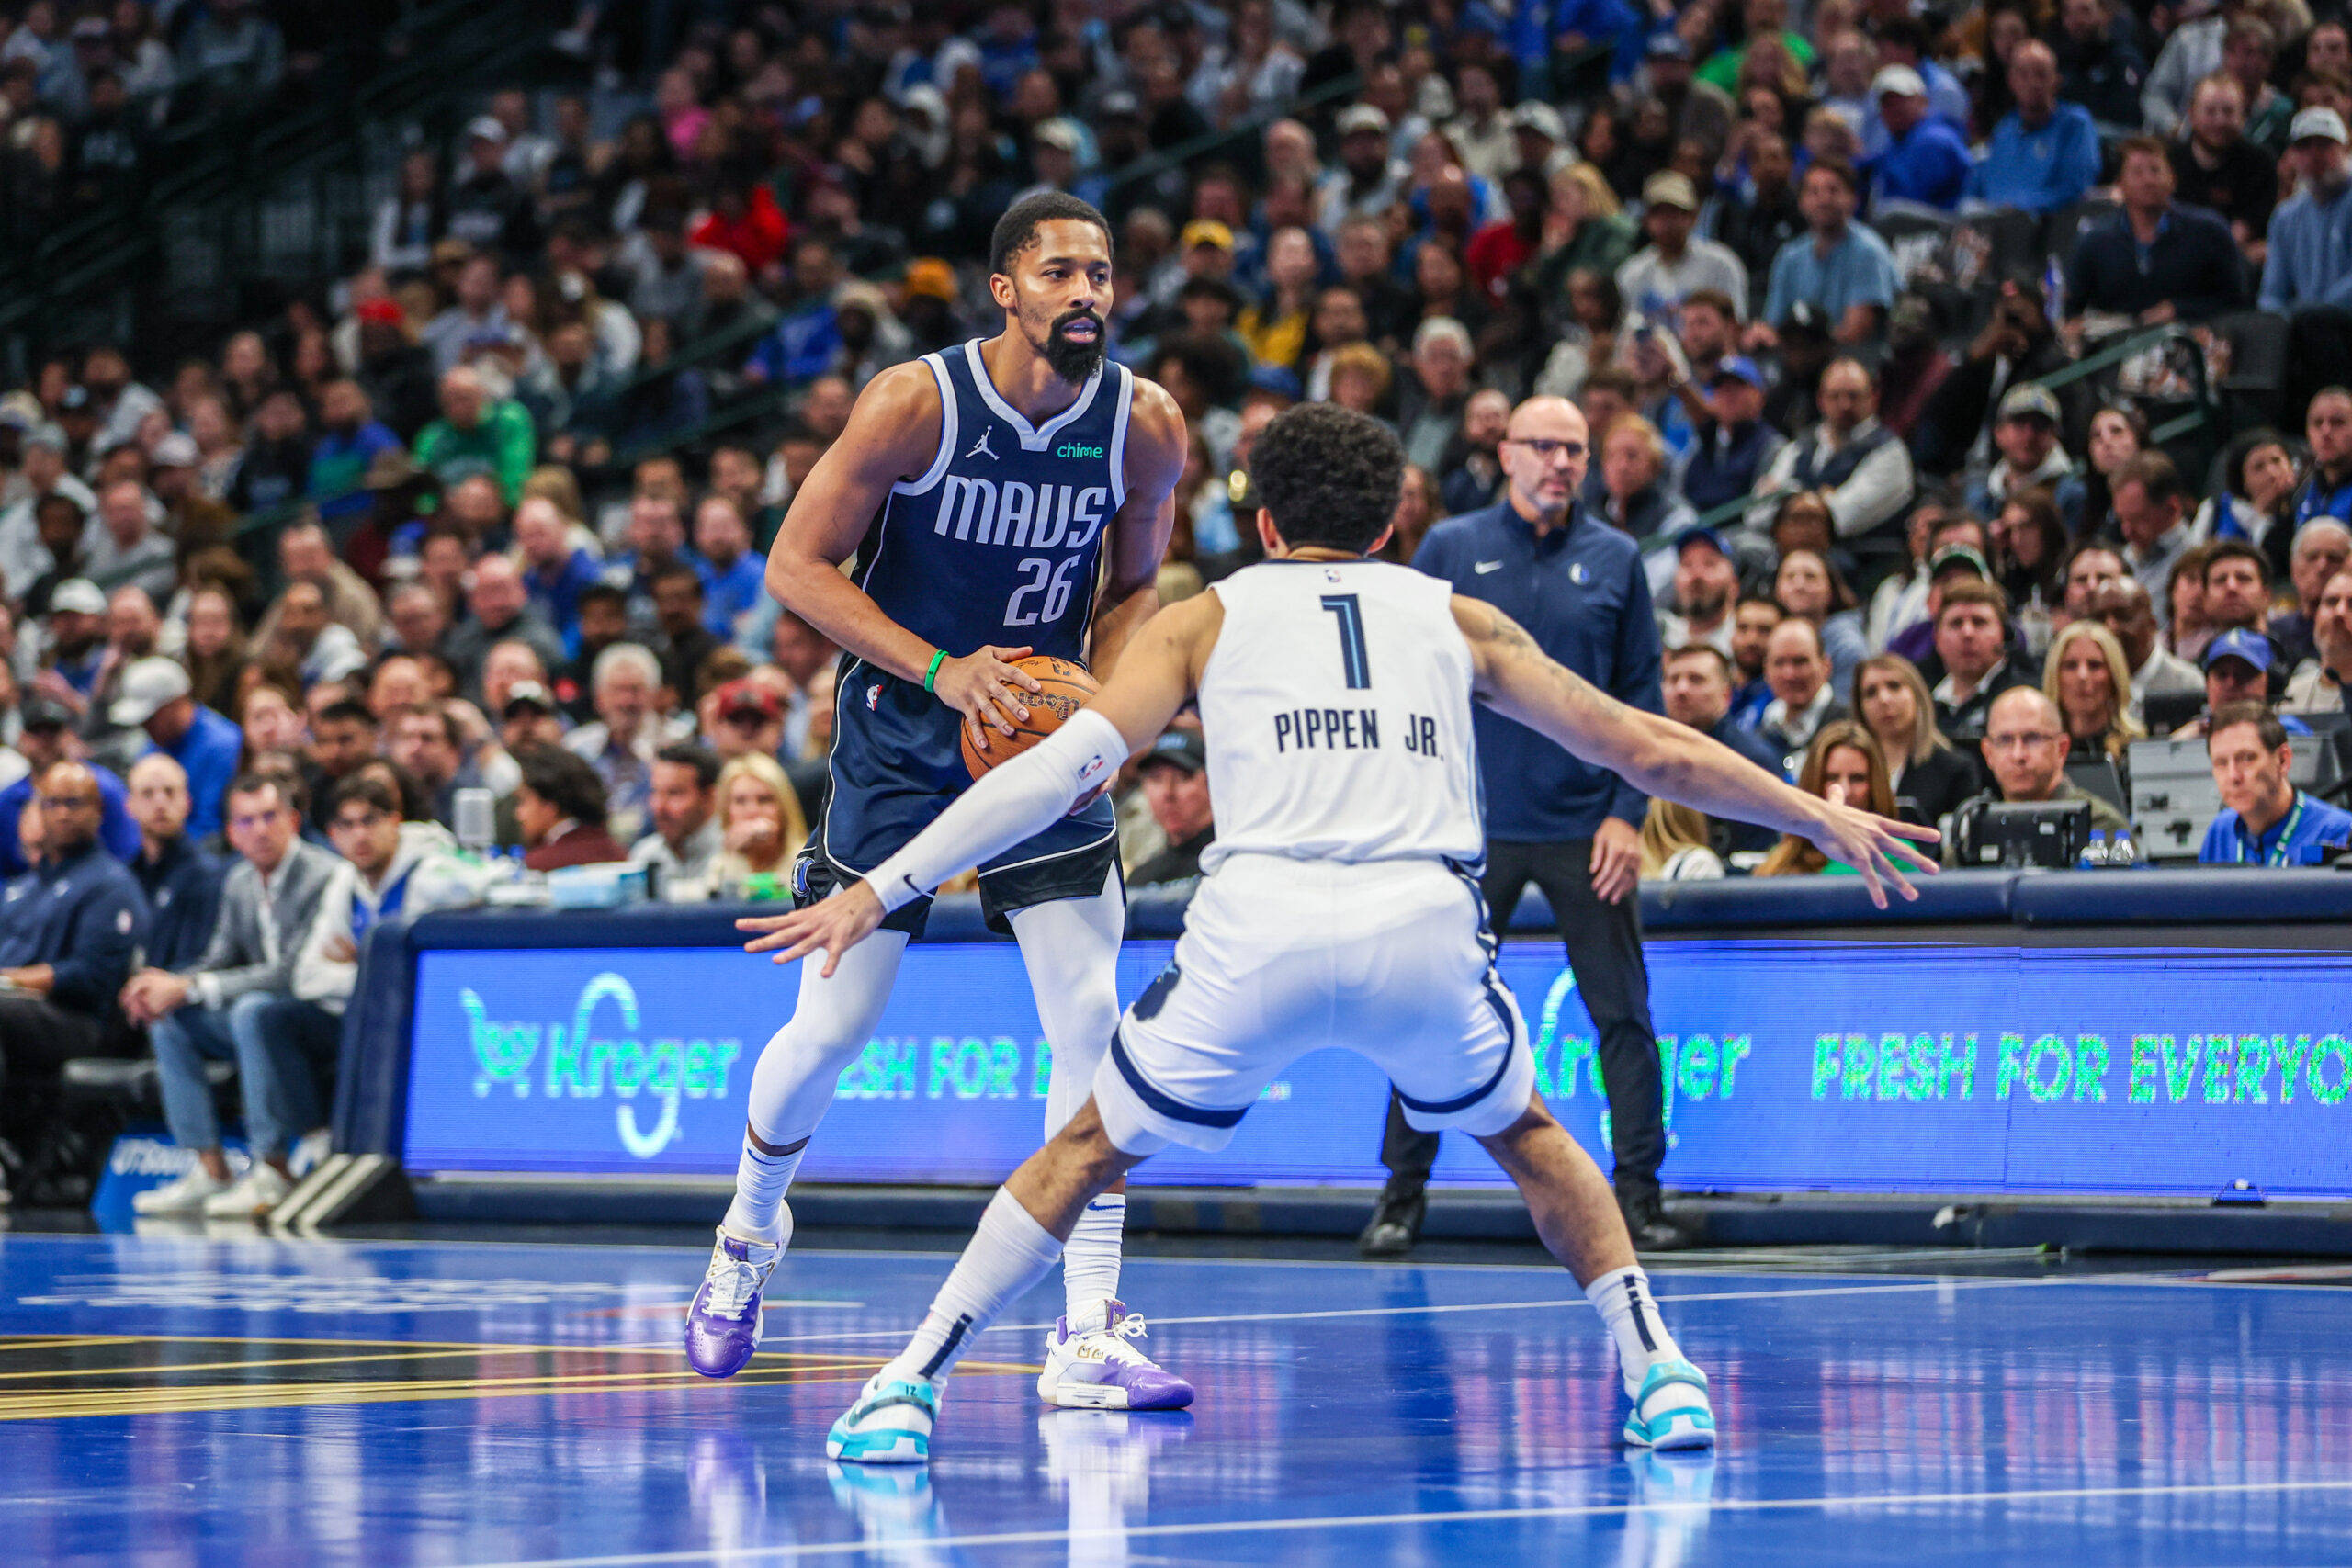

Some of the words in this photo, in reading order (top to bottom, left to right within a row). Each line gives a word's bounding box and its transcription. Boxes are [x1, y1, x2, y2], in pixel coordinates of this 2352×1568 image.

[1057, 442, 1103, 458] chime
[934, 474, 1108, 548] MAVS
[1003, 553, 1082, 626] 26
[1319, 593, 1372, 690] 1
[1274, 709, 1381, 754] PIPPEN
[1404, 713, 1444, 762] JR.
[546, 971, 742, 1159] Kroger
[926, 1036, 1021, 1100] FOR
[1811, 1032, 1978, 1102] FRESH
[1995, 1032, 2109, 1103] FOR
